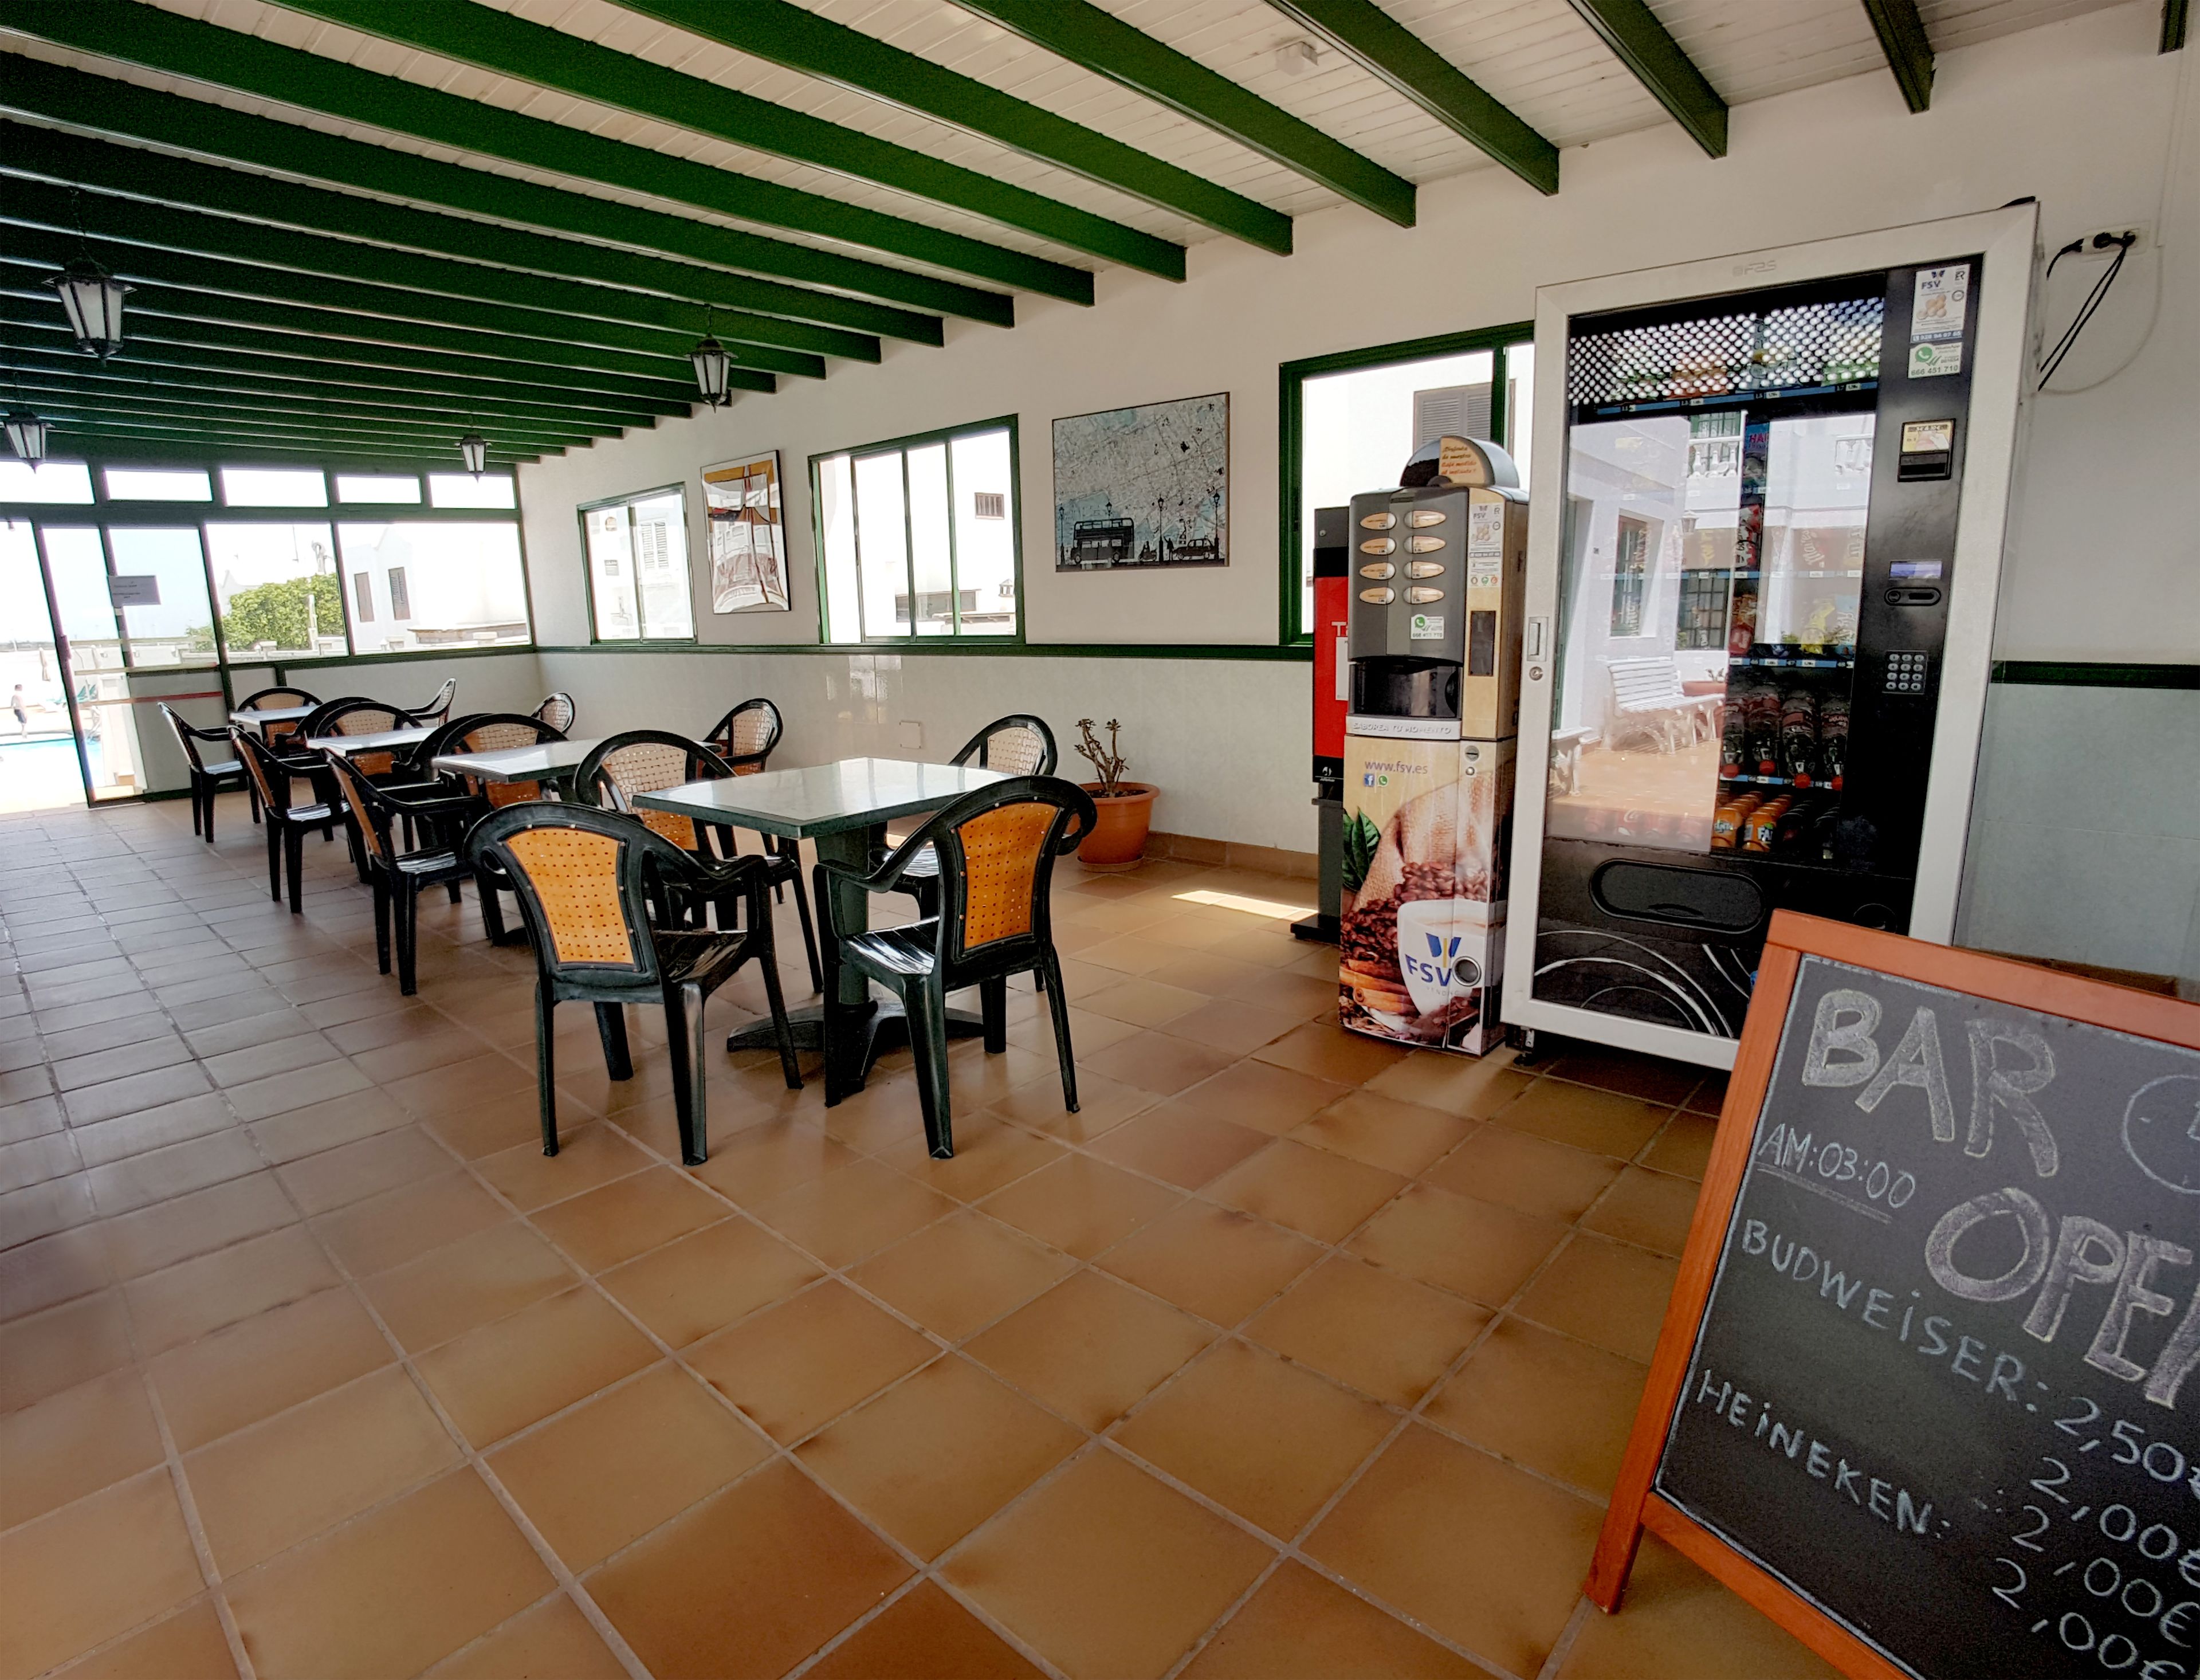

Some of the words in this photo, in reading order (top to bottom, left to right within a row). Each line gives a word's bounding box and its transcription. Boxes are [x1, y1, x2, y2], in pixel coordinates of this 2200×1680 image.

[1921, 280, 1941, 290] FSV
[1353, 722, 1389, 732] SABOREA
[1365, 760, 1428, 774] www.fsv.es
[1405, 953, 1453, 987] FSV
[1802, 988, 2060, 1178] BAR
